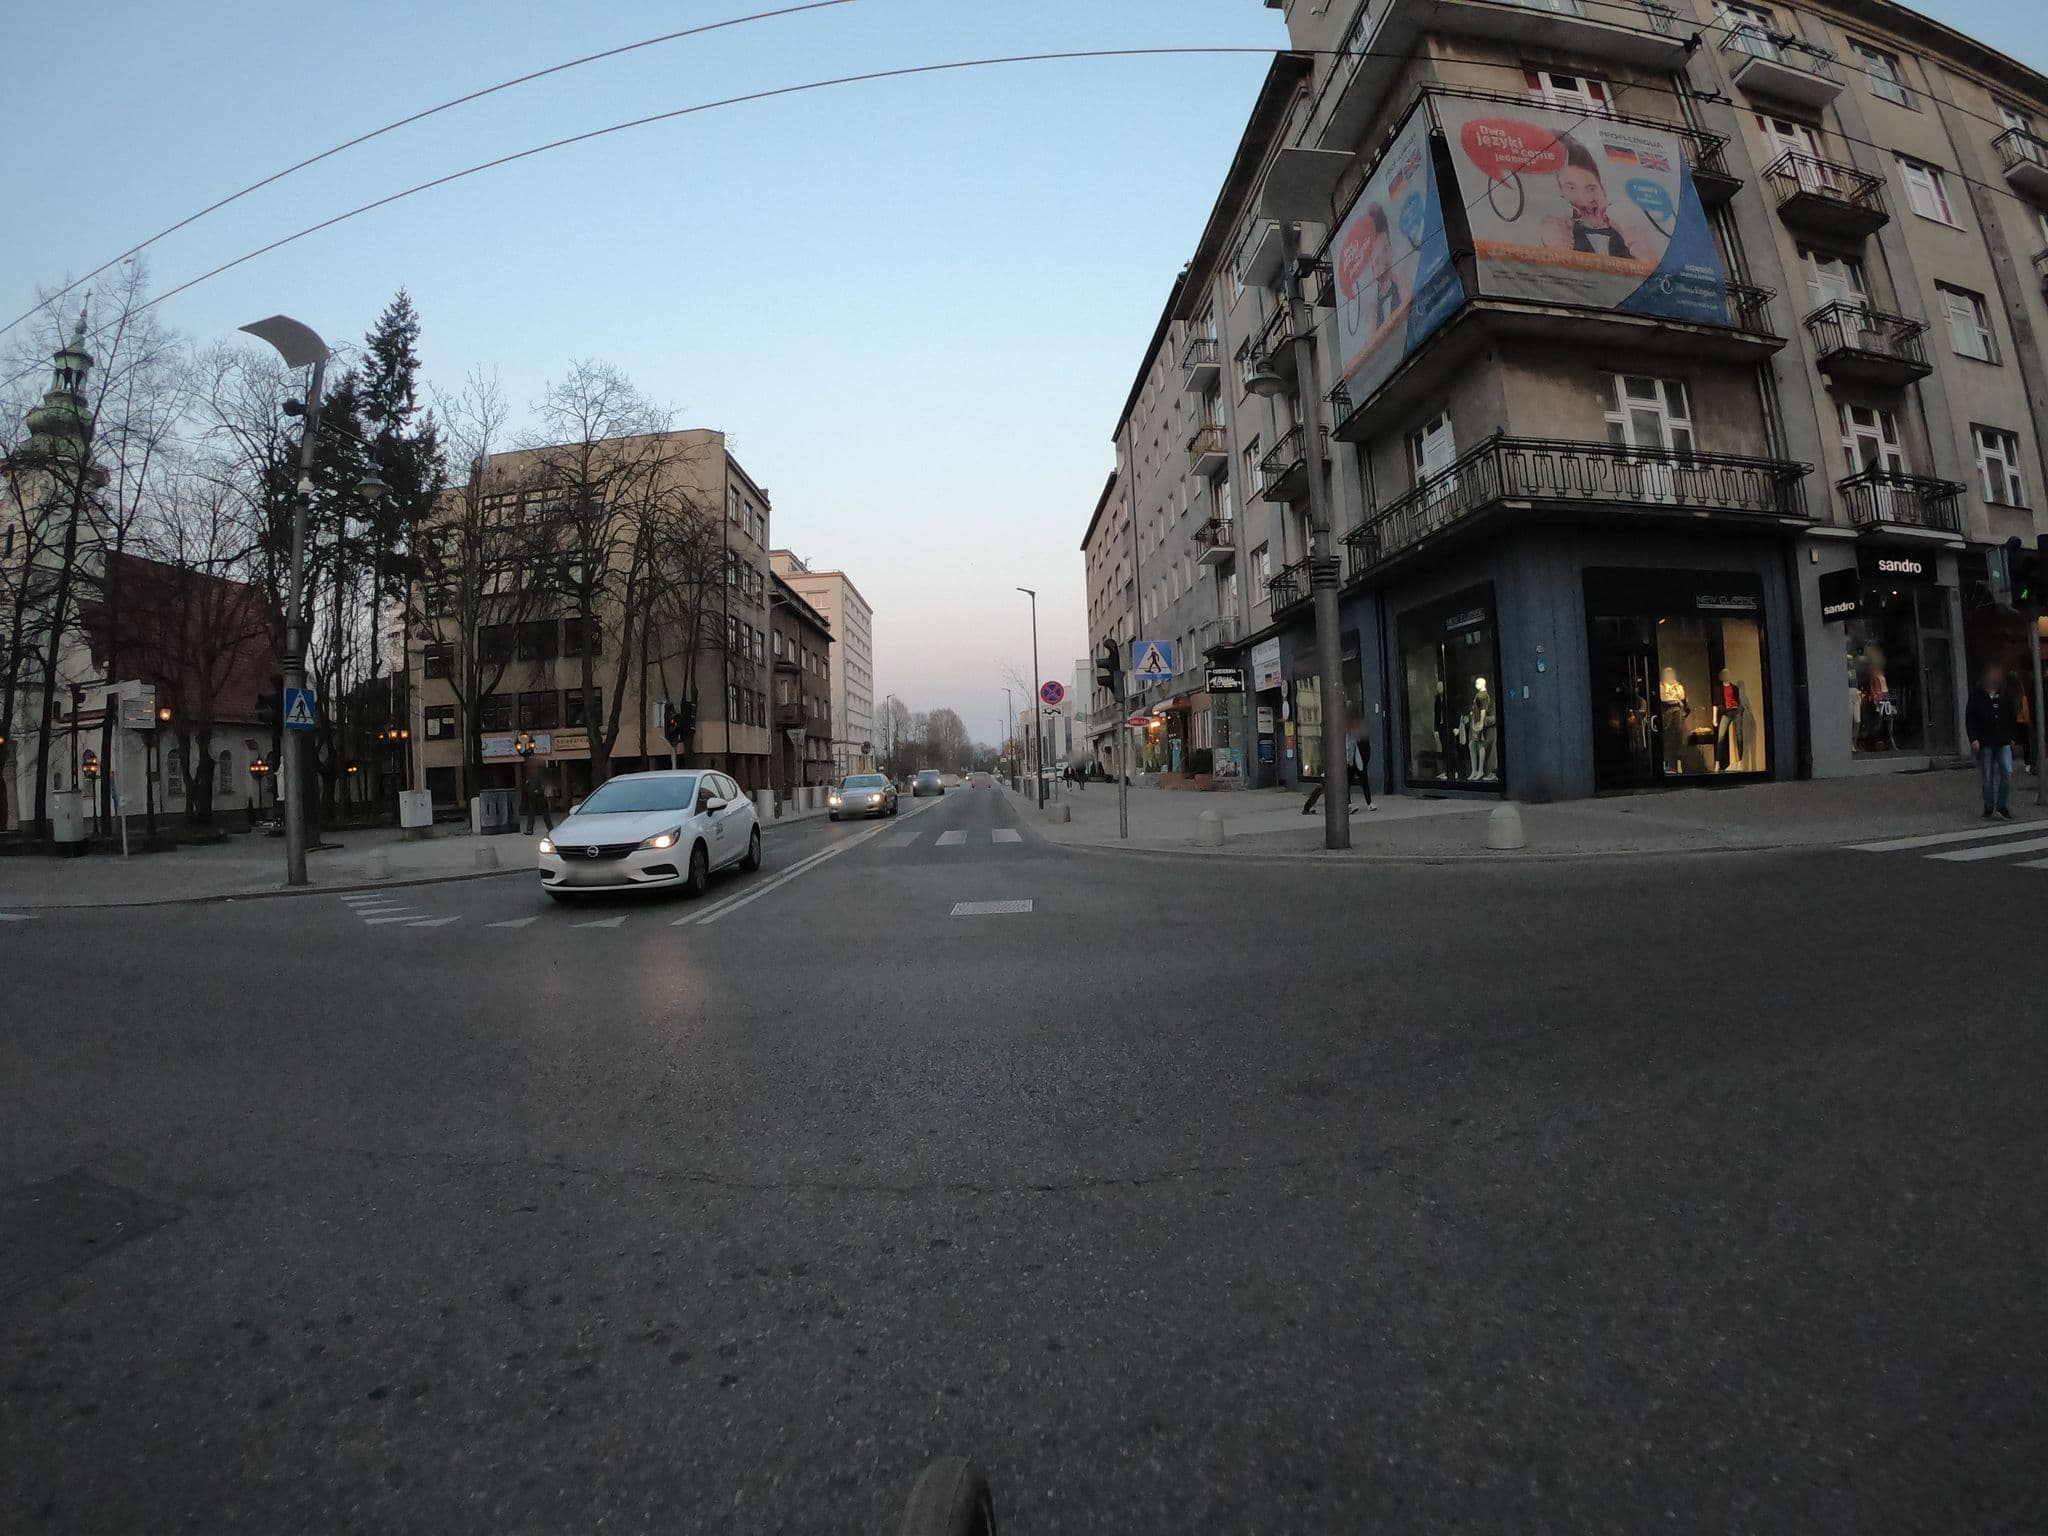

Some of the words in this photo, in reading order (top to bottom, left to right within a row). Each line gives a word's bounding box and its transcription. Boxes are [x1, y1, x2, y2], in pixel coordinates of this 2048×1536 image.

[1478, 125, 1506, 137] Dwa
[1476, 132, 1524, 149] języki
[1520, 149, 1556, 161] cenie
[1878, 558, 1922, 573] sandro
[1823, 601, 1855, 615] sandro
